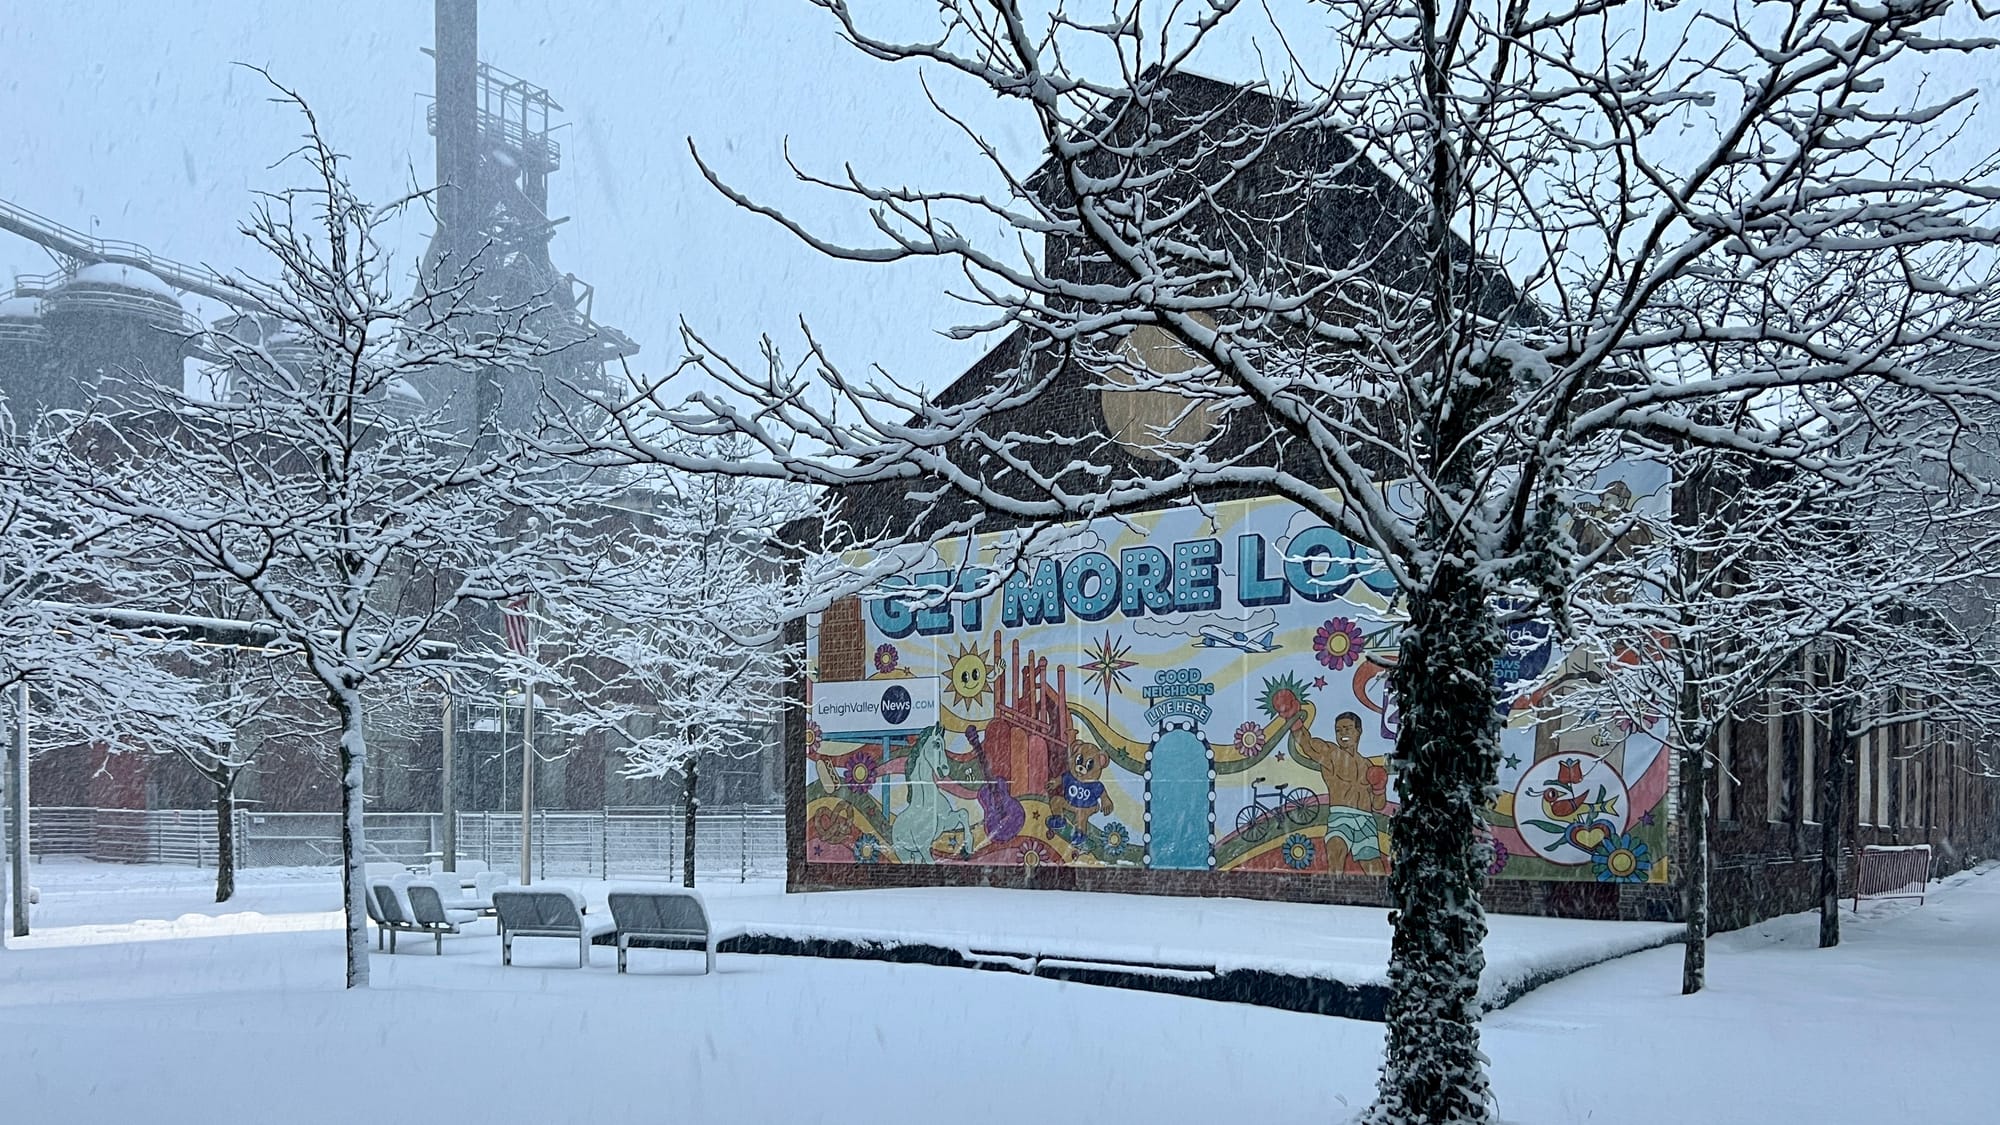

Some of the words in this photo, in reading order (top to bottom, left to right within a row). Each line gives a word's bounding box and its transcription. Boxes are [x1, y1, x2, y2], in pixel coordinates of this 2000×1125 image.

[870, 567, 990, 639] GET
[1001, 538, 1222, 628] MORE
[1154, 667, 1202, 685] GOOD
[1142, 682, 1215, 699] NEIGHBORS
[1148, 702, 1174, 721] LIVE
[1176, 701, 1209, 720] HERE
